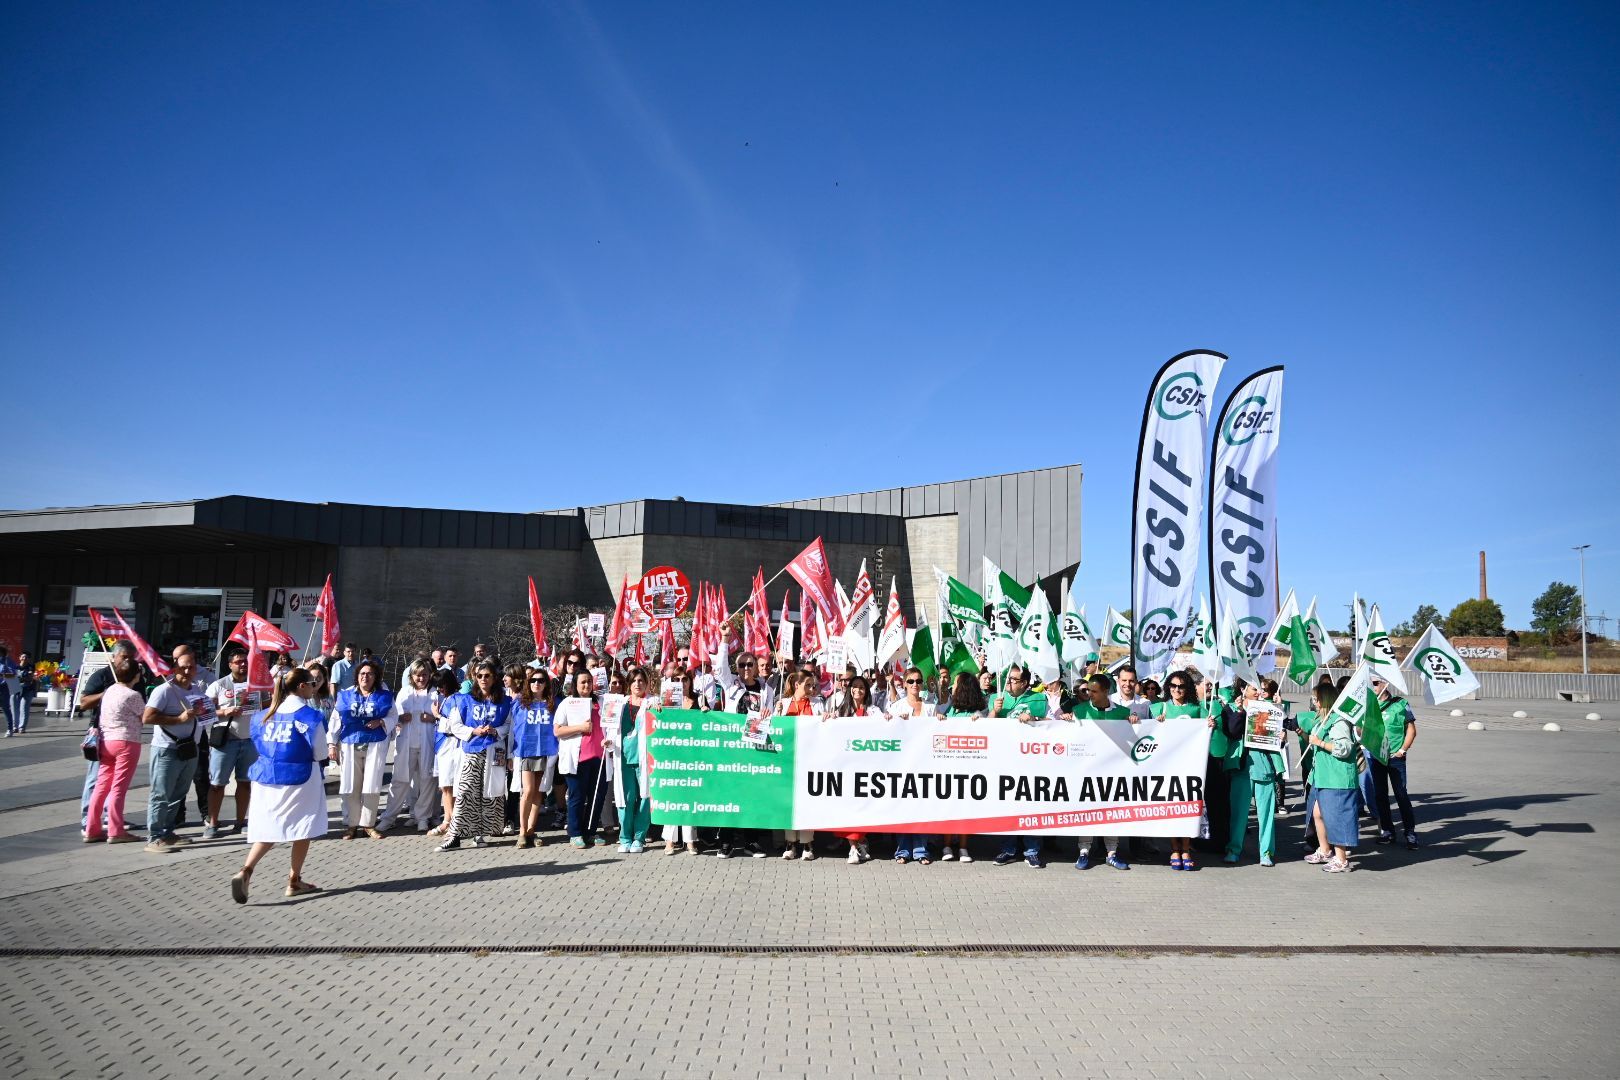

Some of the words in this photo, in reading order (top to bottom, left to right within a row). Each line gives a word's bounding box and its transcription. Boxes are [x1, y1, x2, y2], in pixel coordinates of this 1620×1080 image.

[1165, 385, 1206, 407] CSIF
[1233, 411, 1273, 429] CSIF
[1143, 439, 1192, 588] CSIF
[1221, 465, 1264, 598] CSIF
[643, 571, 680, 596] UGT
[1143, 624, 1183, 644] CSIF
[1244, 632, 1269, 650] SIF
[1427, 654, 1457, 685] CSIF
[652, 720, 692, 733] Nueva
[651, 736, 720, 749] profesional
[852, 739, 902, 751] SATSE
[949, 738, 986, 748] CCOO
[1020, 742, 1050, 755] UGT
[1136, 743, 1158, 754] CSIF
[651, 759, 713, 772] Jubilación
[717, 761, 782, 775] anticipada
[659, 777, 703, 788] parcial
[808, 771, 843, 797] UN
[854, 772, 988, 801] ESTATUTO
[999, 774, 1069, 802] PARA
[1079, 775, 1204, 802] AVANZAR
[650, 799, 690, 813] Mejora
[692, 801, 740, 813] jornada
[1019, 817, 1039, 828] POR
[1041, 815, 1055, 826] UN
[1057, 811, 1104, 825] ESTATUTO
[1106, 809, 1131, 821] PARA
[1133, 803, 1200, 818] TODOS/TODAS
